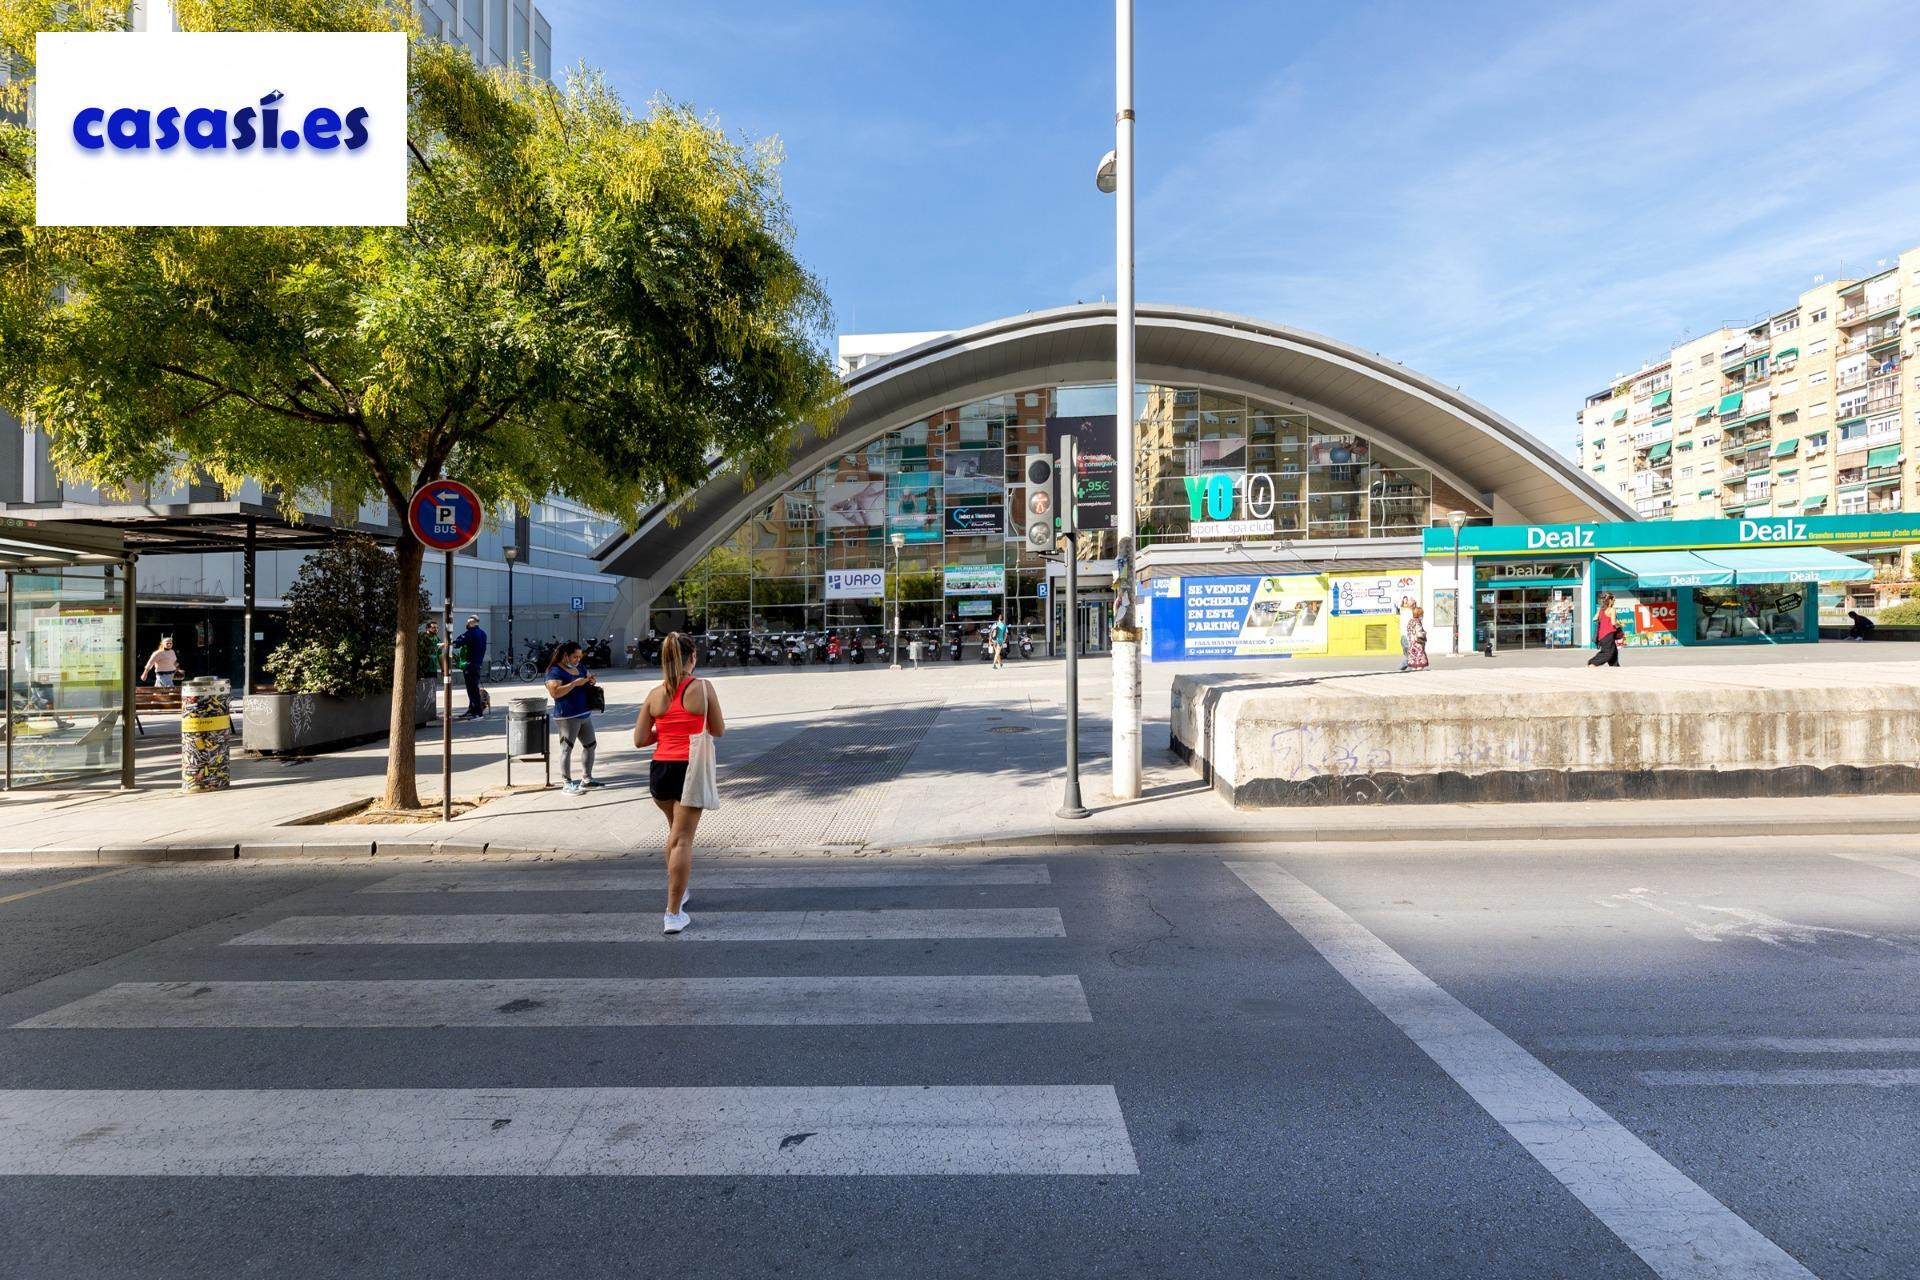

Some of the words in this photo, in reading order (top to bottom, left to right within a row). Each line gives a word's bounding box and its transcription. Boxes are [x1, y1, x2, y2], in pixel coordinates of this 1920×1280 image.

[439, 507, 452, 522] P
[434, 525, 457, 534] BUS
[1192, 524, 1220, 535] sport
[1227, 523, 1247, 534] spa
[1249, 520, 1273, 532] club
[1739, 519, 1807, 542] Dealz
[1528, 525, 1595, 549] Dealz
[1505, 564, 1546, 578] Dealz
[1790, 571, 1820, 582] Dealz
[844, 573, 881, 586] UAPO
[1670, 574, 1701, 585] Dealz
[1188, 585, 1203, 595] SE
[1204, 584, 1251, 594] VENDEN
[1188, 597, 1249, 607] COCHERAS
[1188, 610, 1204, 619] EN
[1206, 609, 1235, 618] ESTE
[1188, 621, 1240, 632] PARKING
